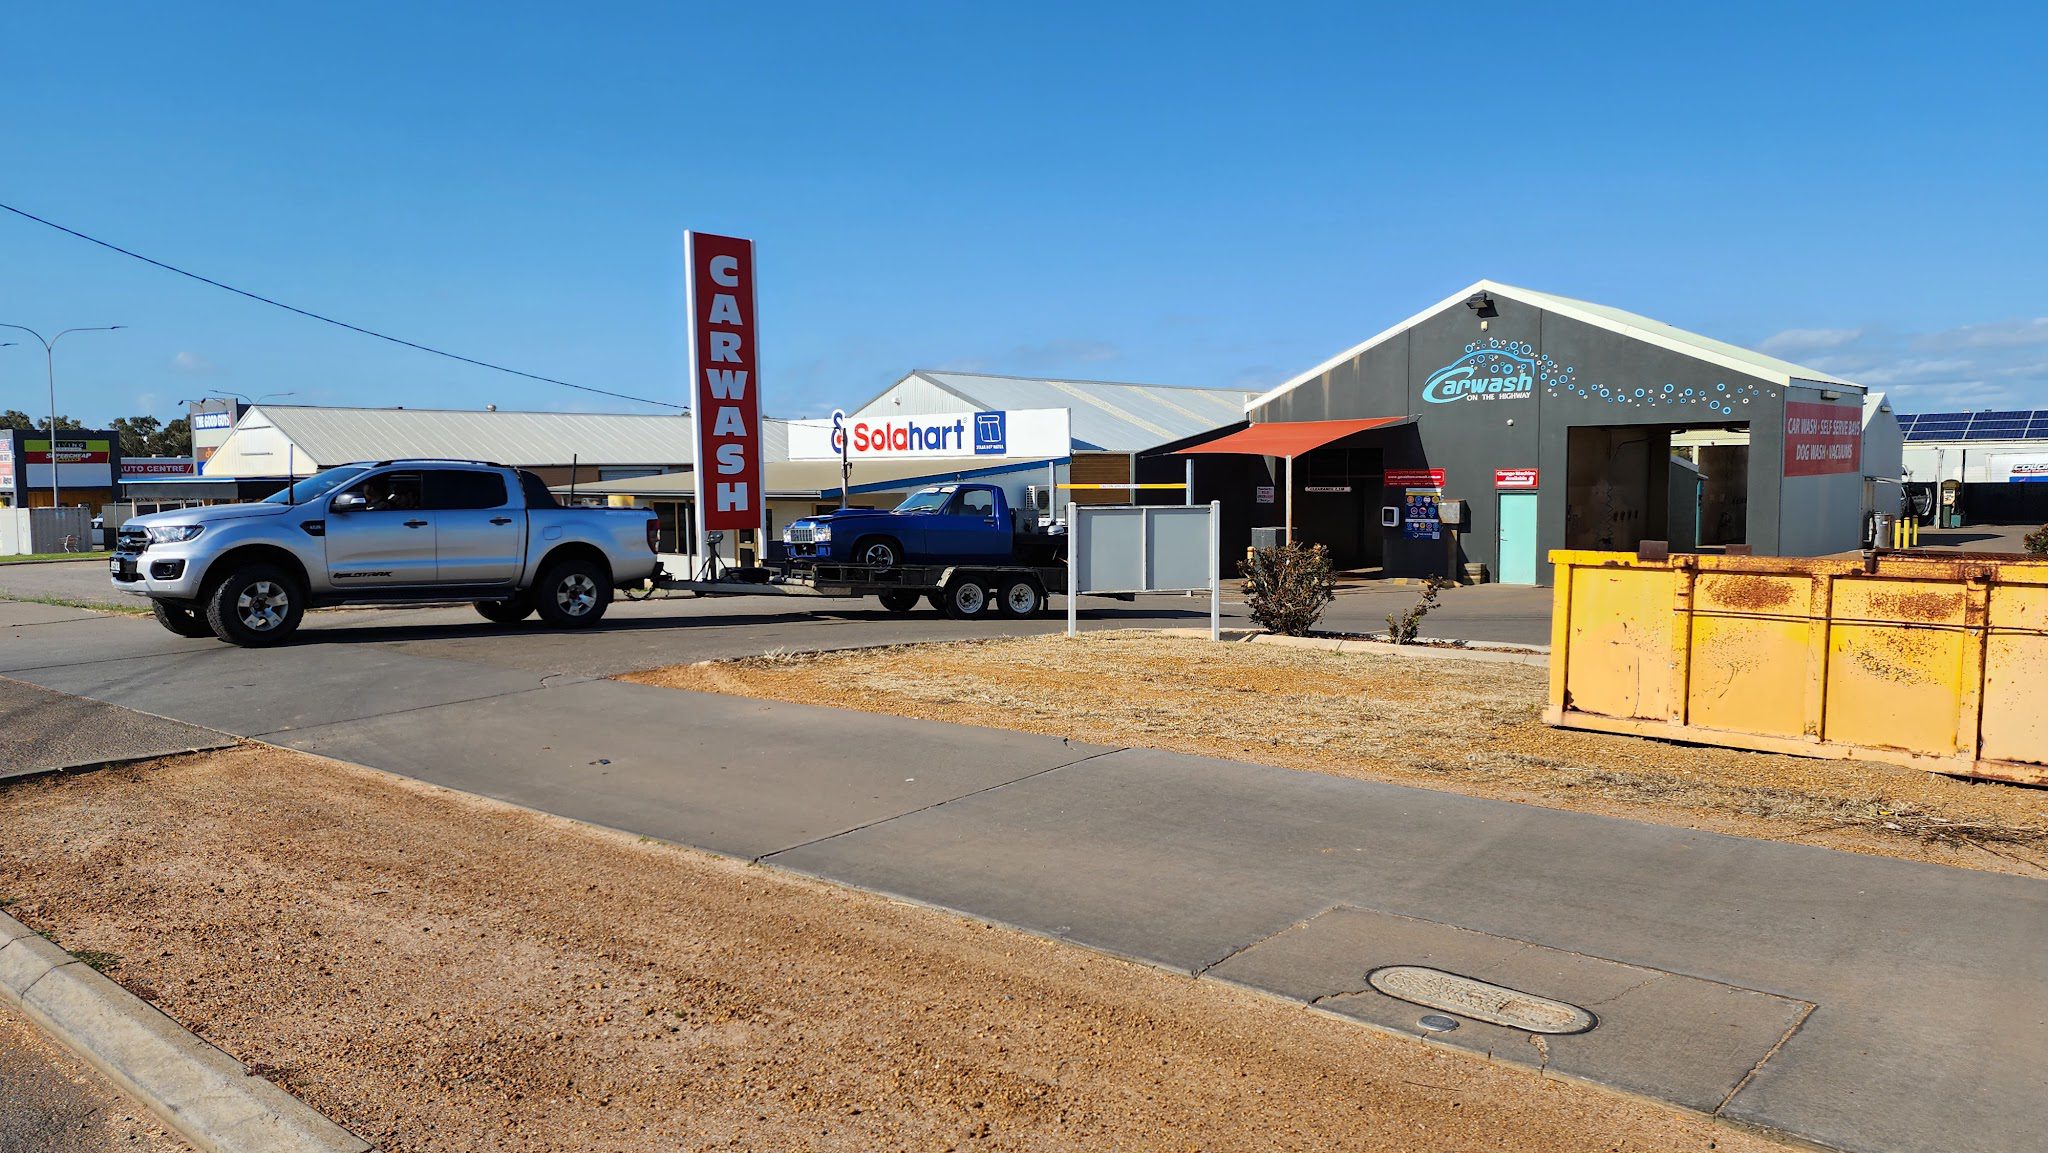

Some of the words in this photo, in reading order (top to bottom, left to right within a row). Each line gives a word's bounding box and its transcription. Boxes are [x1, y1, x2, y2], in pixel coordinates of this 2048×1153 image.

[705, 254, 749, 512] CARWASH
[1422, 367, 1533, 404] Carwash
[1481, 393, 1495, 401] THE
[1499, 391, 1532, 400] HIGHWAY
[204, 414, 217, 428] GOOD
[217, 413, 230, 427] GUYS
[1788, 418, 1800, 434] CAR
[1801, 418, 1818, 435] WASH
[1820, 419, 1832, 435] SELF
[1832, 420, 1848, 436] SERVE
[854, 417, 964, 451] Solahart
[1796, 444, 1809, 460] DOG
[1810, 443, 1826, 460] WASH
[1828, 443, 1853, 460] VACUUMS
[146, 464, 185, 472] CENTRE
